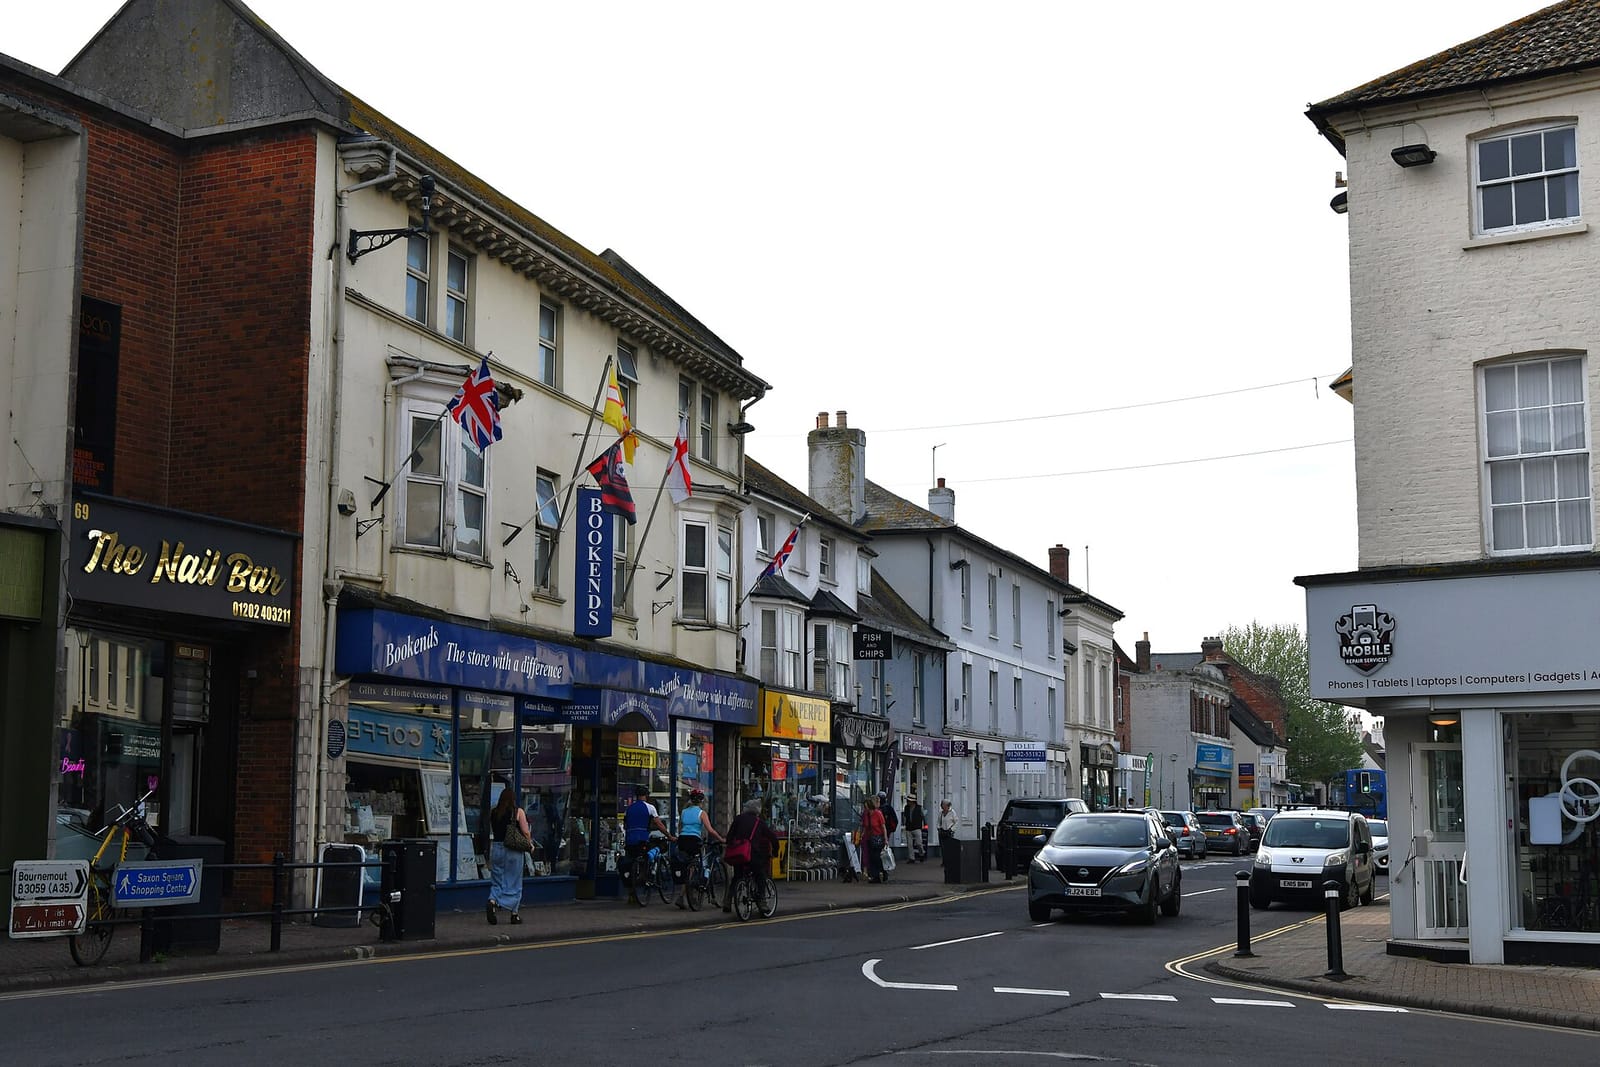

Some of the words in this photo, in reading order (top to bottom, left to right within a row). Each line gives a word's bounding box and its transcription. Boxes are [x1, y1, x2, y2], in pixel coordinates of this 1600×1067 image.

[74, 502, 90, 521] 69
[83, 529, 148, 577] The
[150, 539, 223, 587] Nail
[226, 552, 288, 597] Bar
[588, 497, 603, 626] BOOKENDS
[232, 601, 260, 618] 01202
[260, 603, 291, 624] 403211
[862, 633, 882, 642] FISH
[384, 625, 440, 668] Bookends
[446, 641, 466, 664] The
[467, 650, 492, 668] store
[492, 651, 512, 671] with
[513, 658, 520, 672] a
[520, 655, 563, 680] difference
[859, 649, 885, 658] CHIPS
[1342, 644, 1391, 657] MOBILE
[1328, 680, 1364, 689] Phones
[1372, 679, 1409, 688] Tablets
[1416, 677, 1457, 688] Laptops
[1465, 675, 1525, 686] Computers
[1534, 672, 1581, 683] Gadgets
[359, 685, 376, 695] Gifts
[382, 687, 389, 696] &
[390, 688, 410, 698] Home
[411, 690, 449, 700] Accessories
[683, 684, 694, 700] The
[695, 690, 710, 703] store
[710, 689, 722, 705] with
[727, 691, 754, 711] difference
[789, 701, 828, 722] SUPERPET
[137, 873, 160, 882] Saxon
[161, 872, 184, 883] Square
[18, 883, 46, 894] B3059
[48, 882, 74, 894] (A35)
[131, 885, 165, 896] Shopping
[165, 884, 187, 893] Centre
